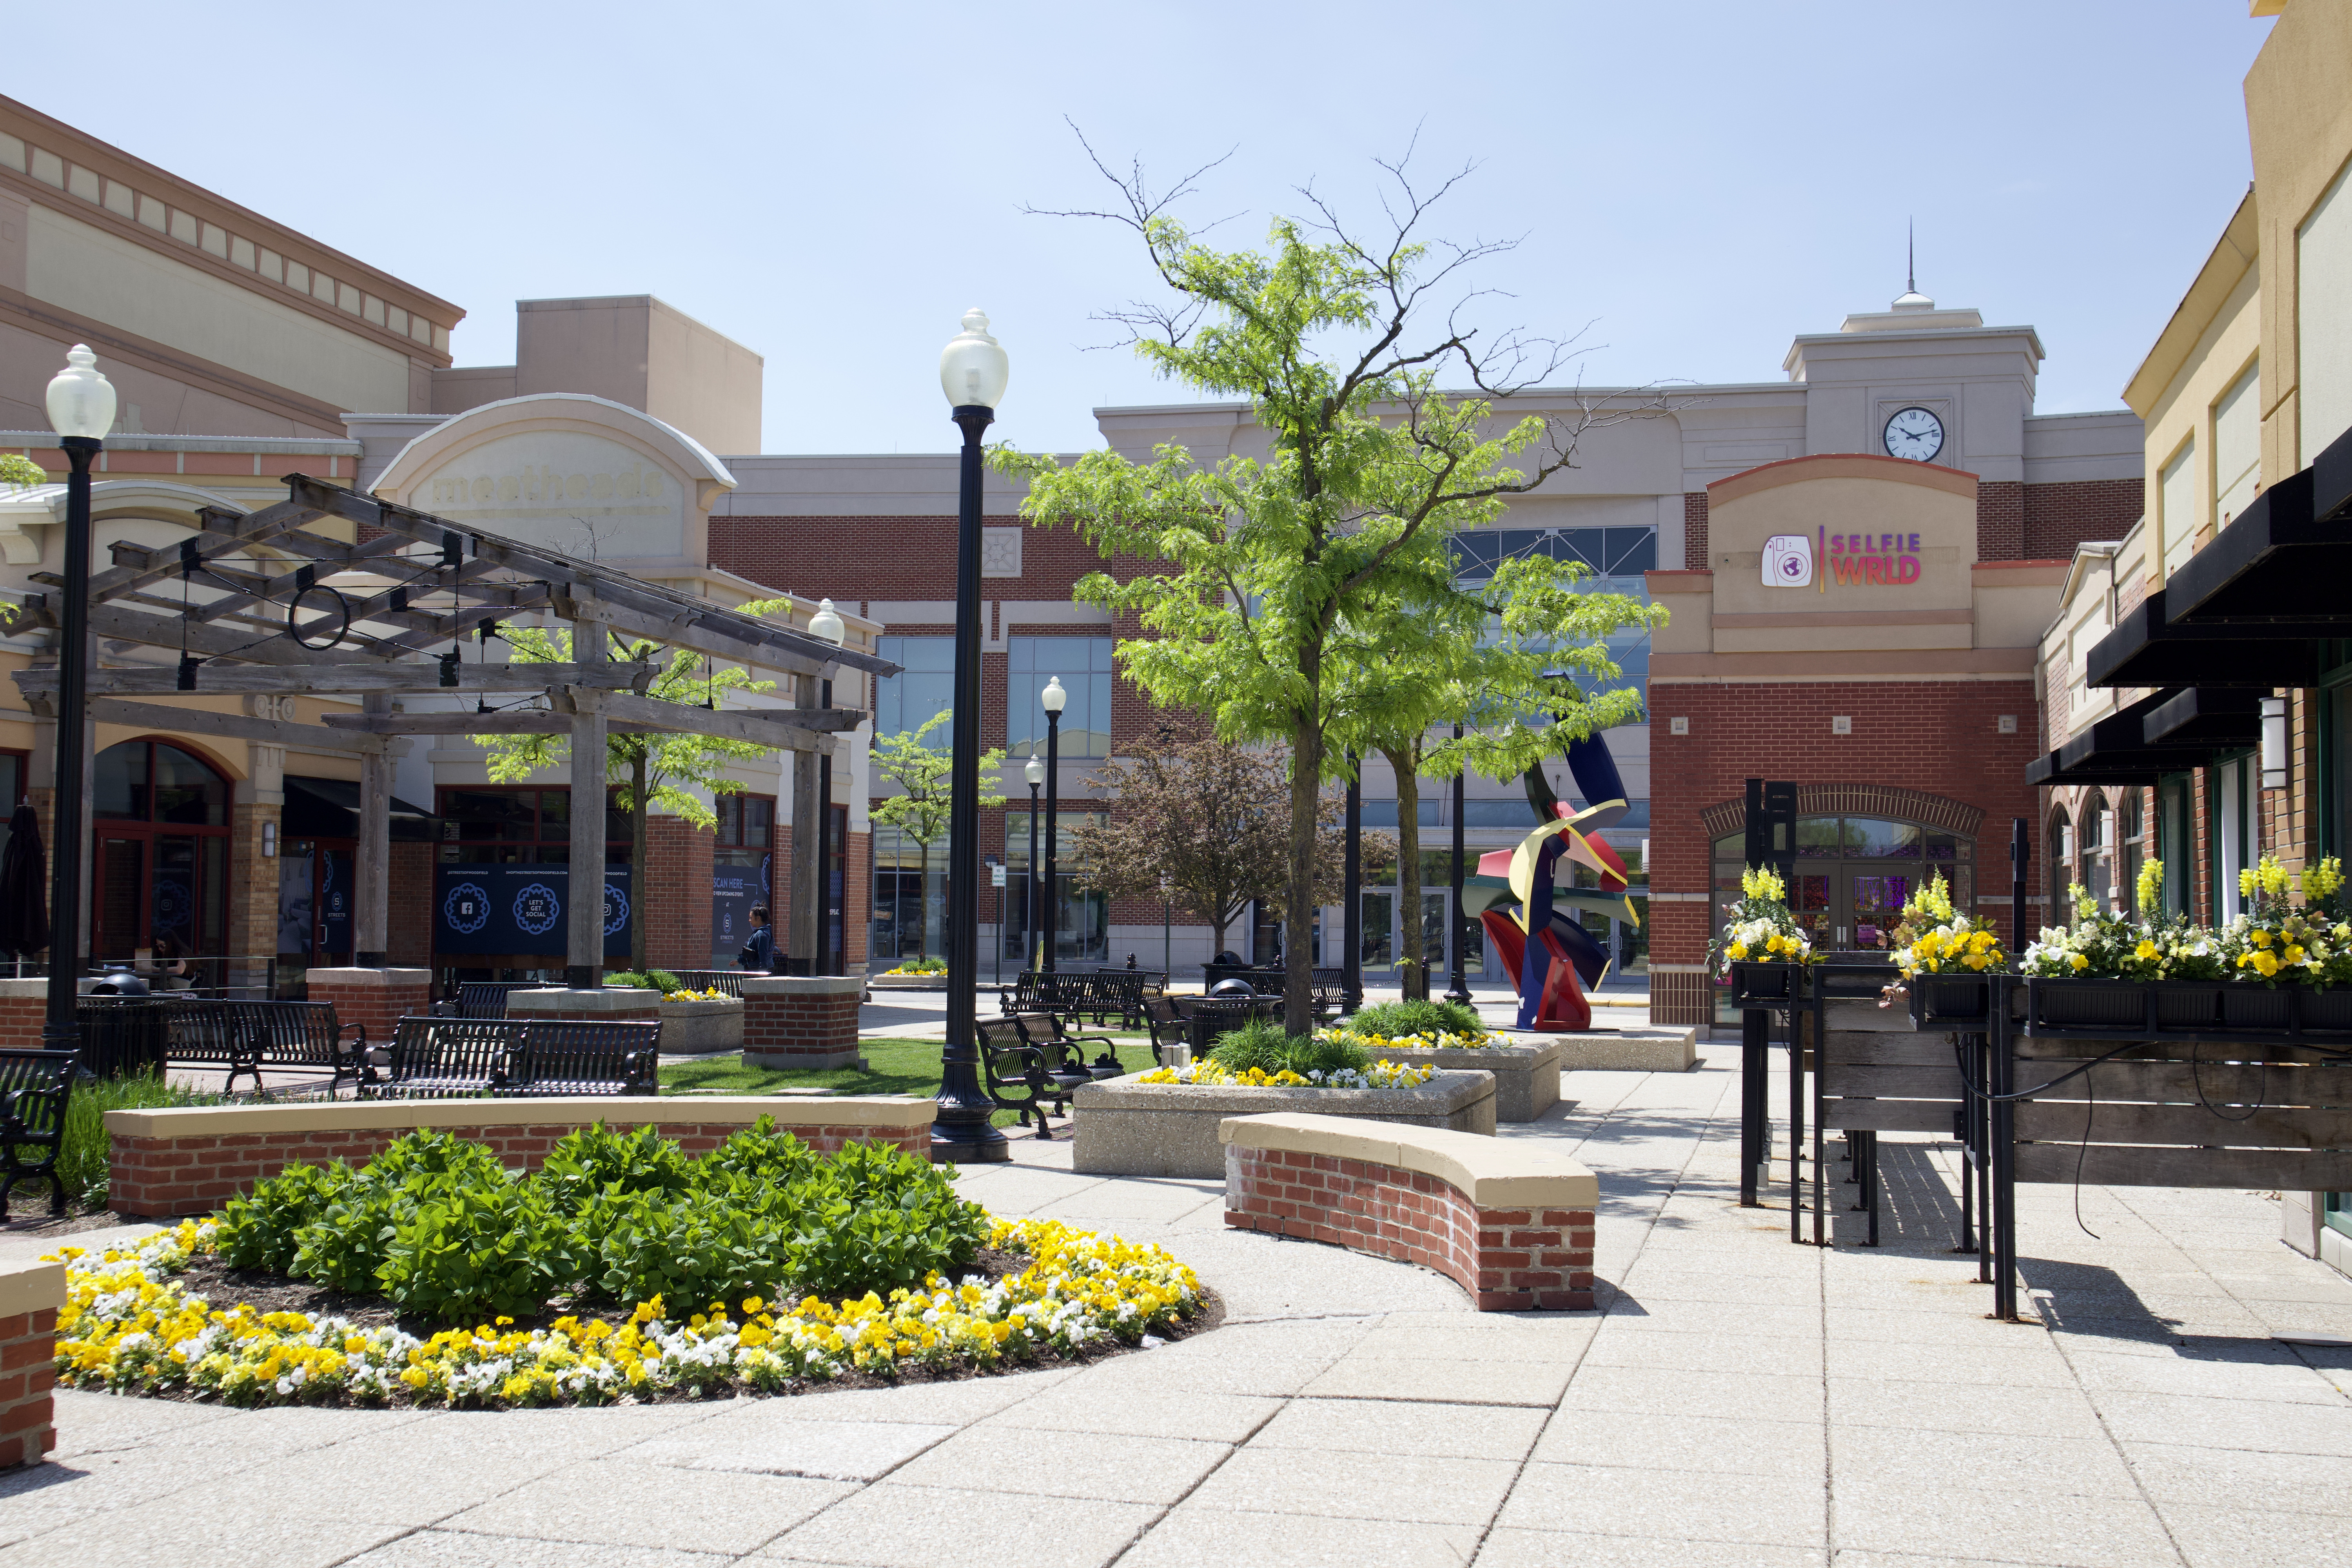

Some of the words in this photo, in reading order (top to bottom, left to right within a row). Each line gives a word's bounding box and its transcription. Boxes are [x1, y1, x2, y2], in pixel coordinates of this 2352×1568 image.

[432, 462, 664, 503] meatheads
[1831, 534, 1920, 554] SELFIE
[1831, 555, 1921, 586] WRLD
[1420, 864, 1434, 872] 601
[713, 877, 728, 888] SCAN
[729, 878, 743, 889] HERE
[1867, 882, 1909, 900] WRL
